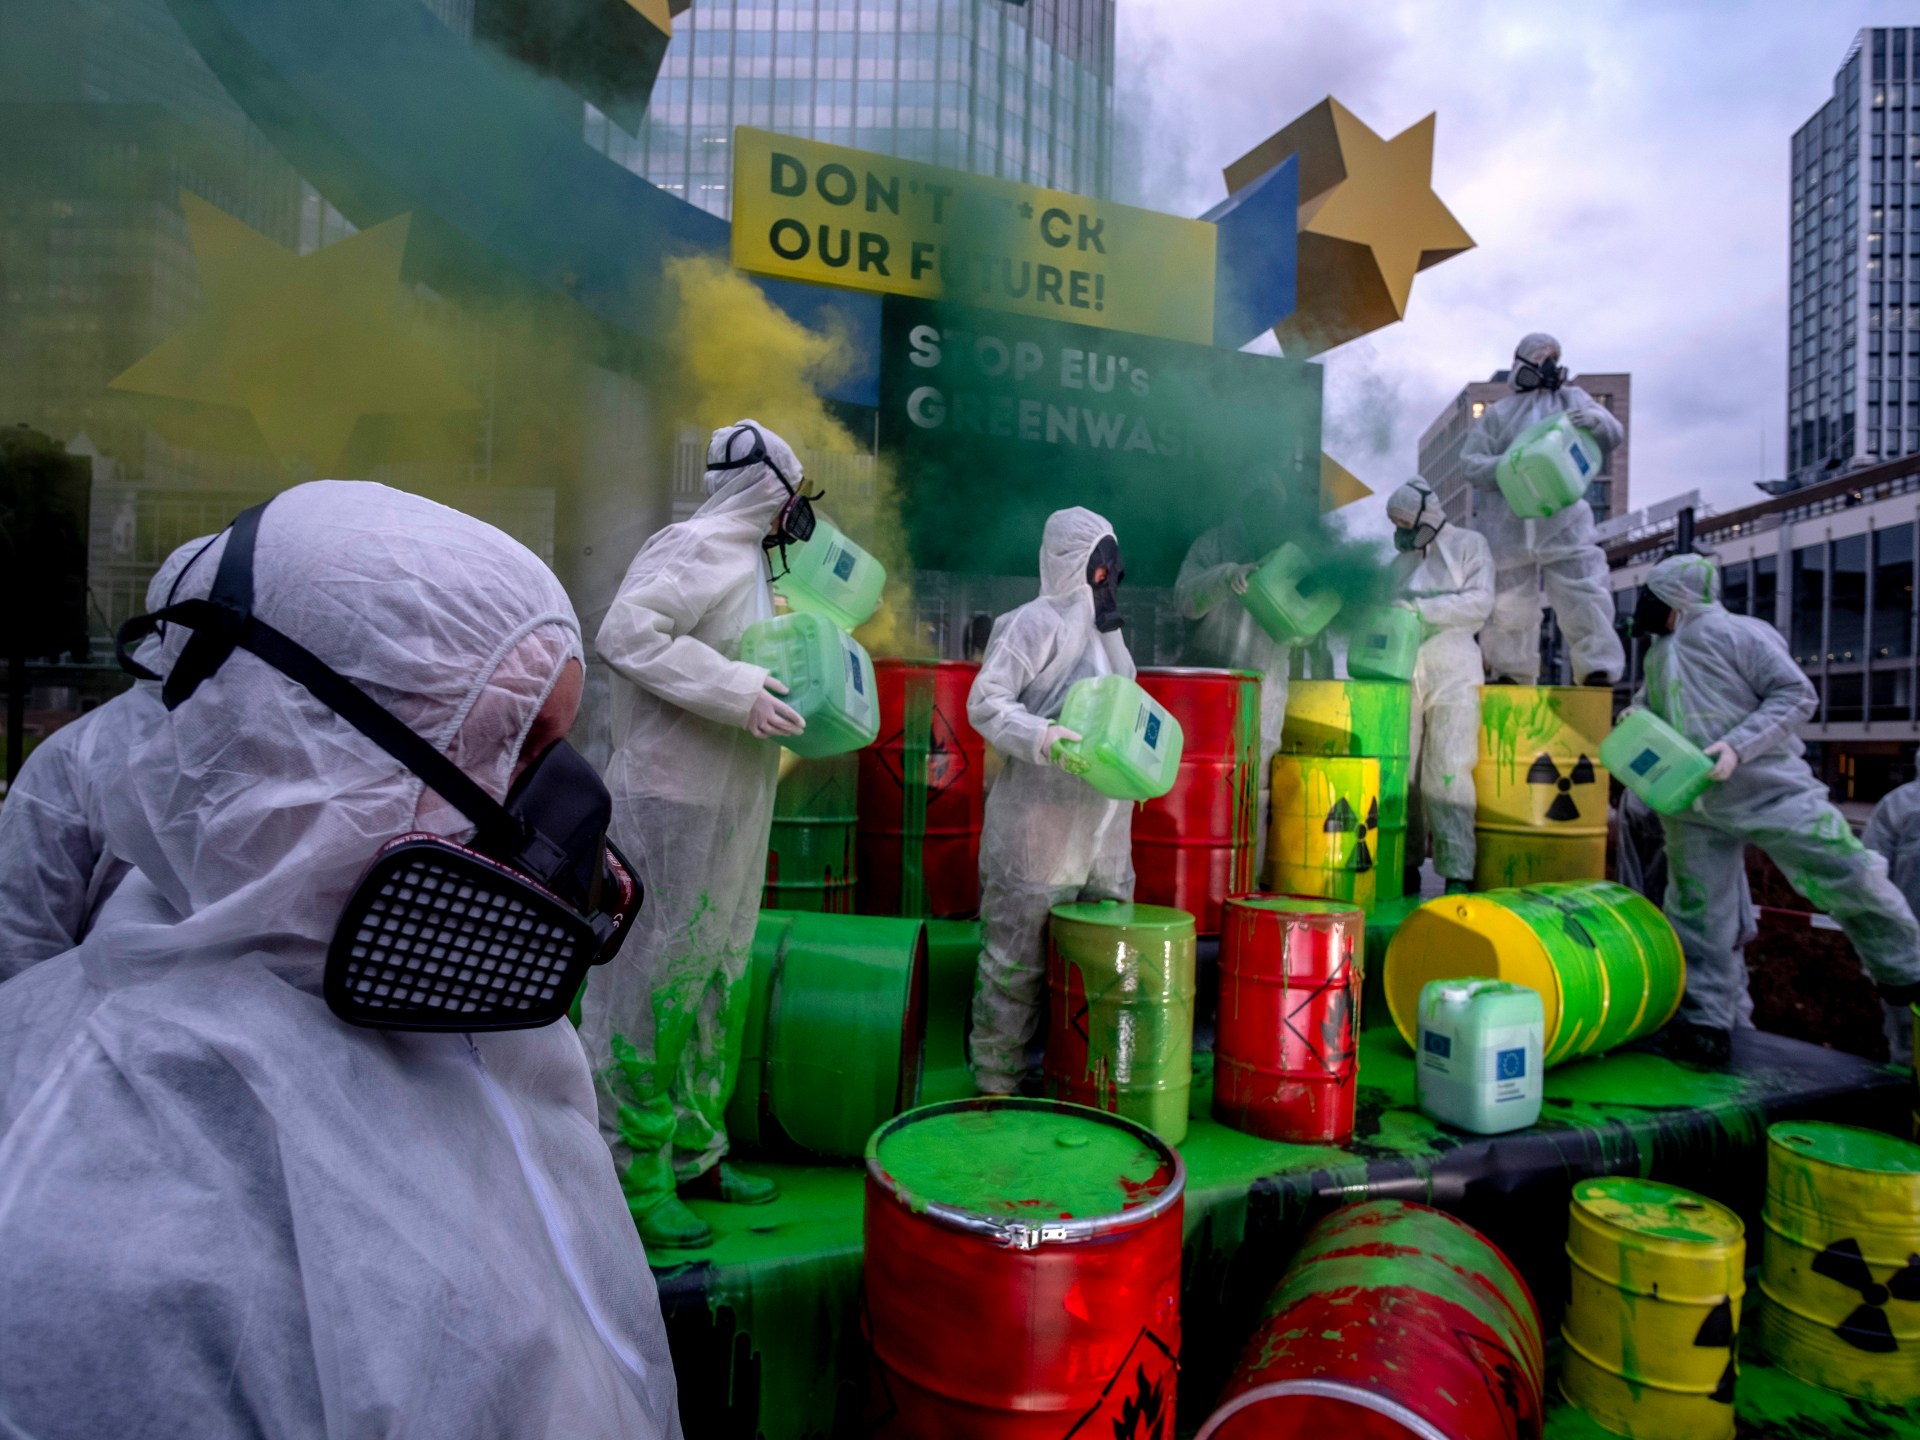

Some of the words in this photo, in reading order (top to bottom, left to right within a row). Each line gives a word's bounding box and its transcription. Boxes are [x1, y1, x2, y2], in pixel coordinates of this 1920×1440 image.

[770, 152, 953, 224] DON'T
[988, 195, 1107, 255] CK
[769, 218, 891, 277] OUR
[1061, 348, 1149, 397] EU's
[906, 386, 1303, 473] GREENWAS!
